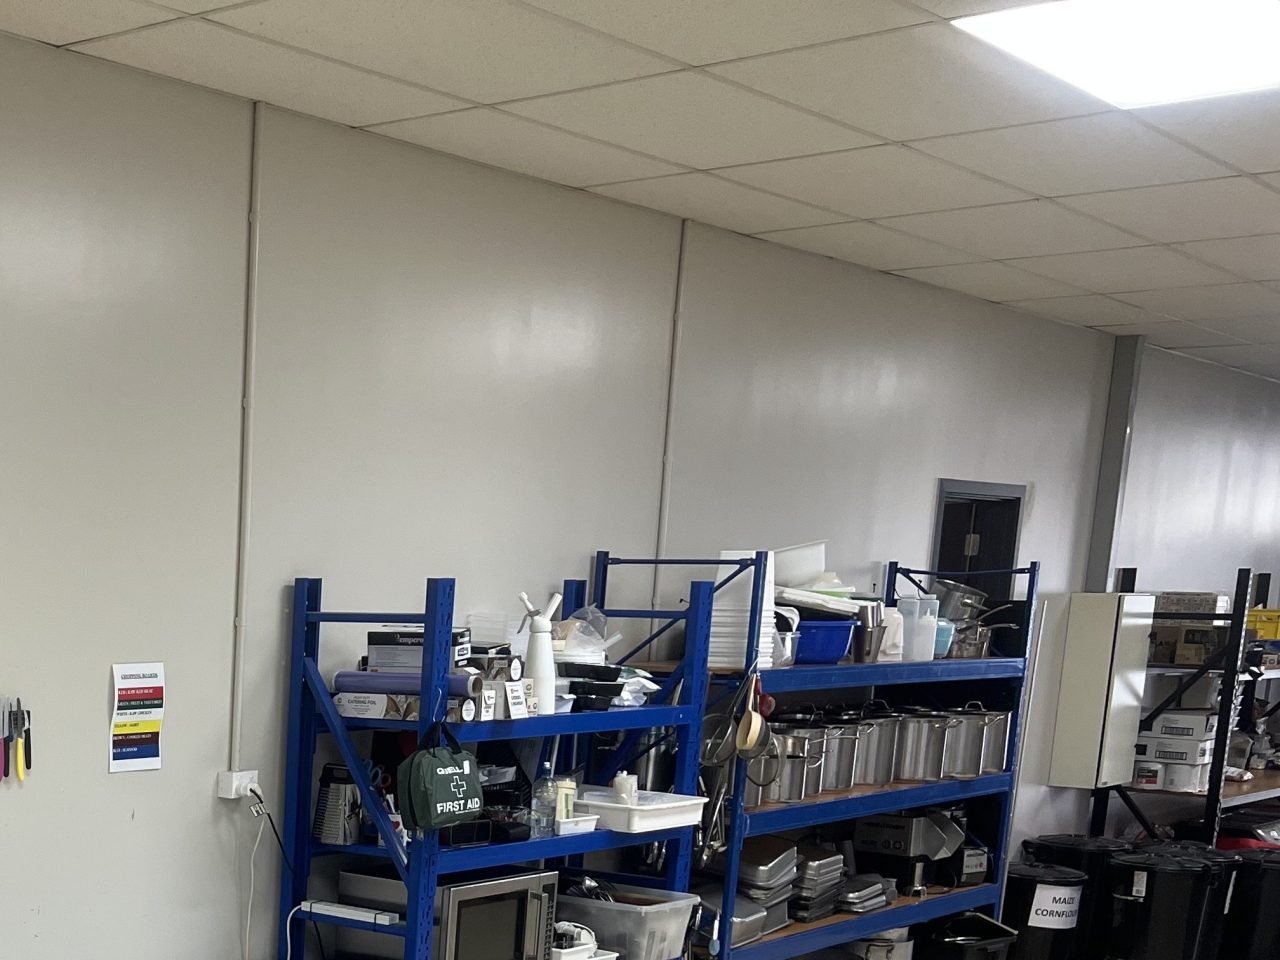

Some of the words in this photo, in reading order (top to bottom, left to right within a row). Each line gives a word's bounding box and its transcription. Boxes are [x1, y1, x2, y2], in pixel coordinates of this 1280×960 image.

[436, 800, 465, 814] FIRST
[466, 797, 481, 810] AID
[1052, 897, 1075, 905] MAIZE
